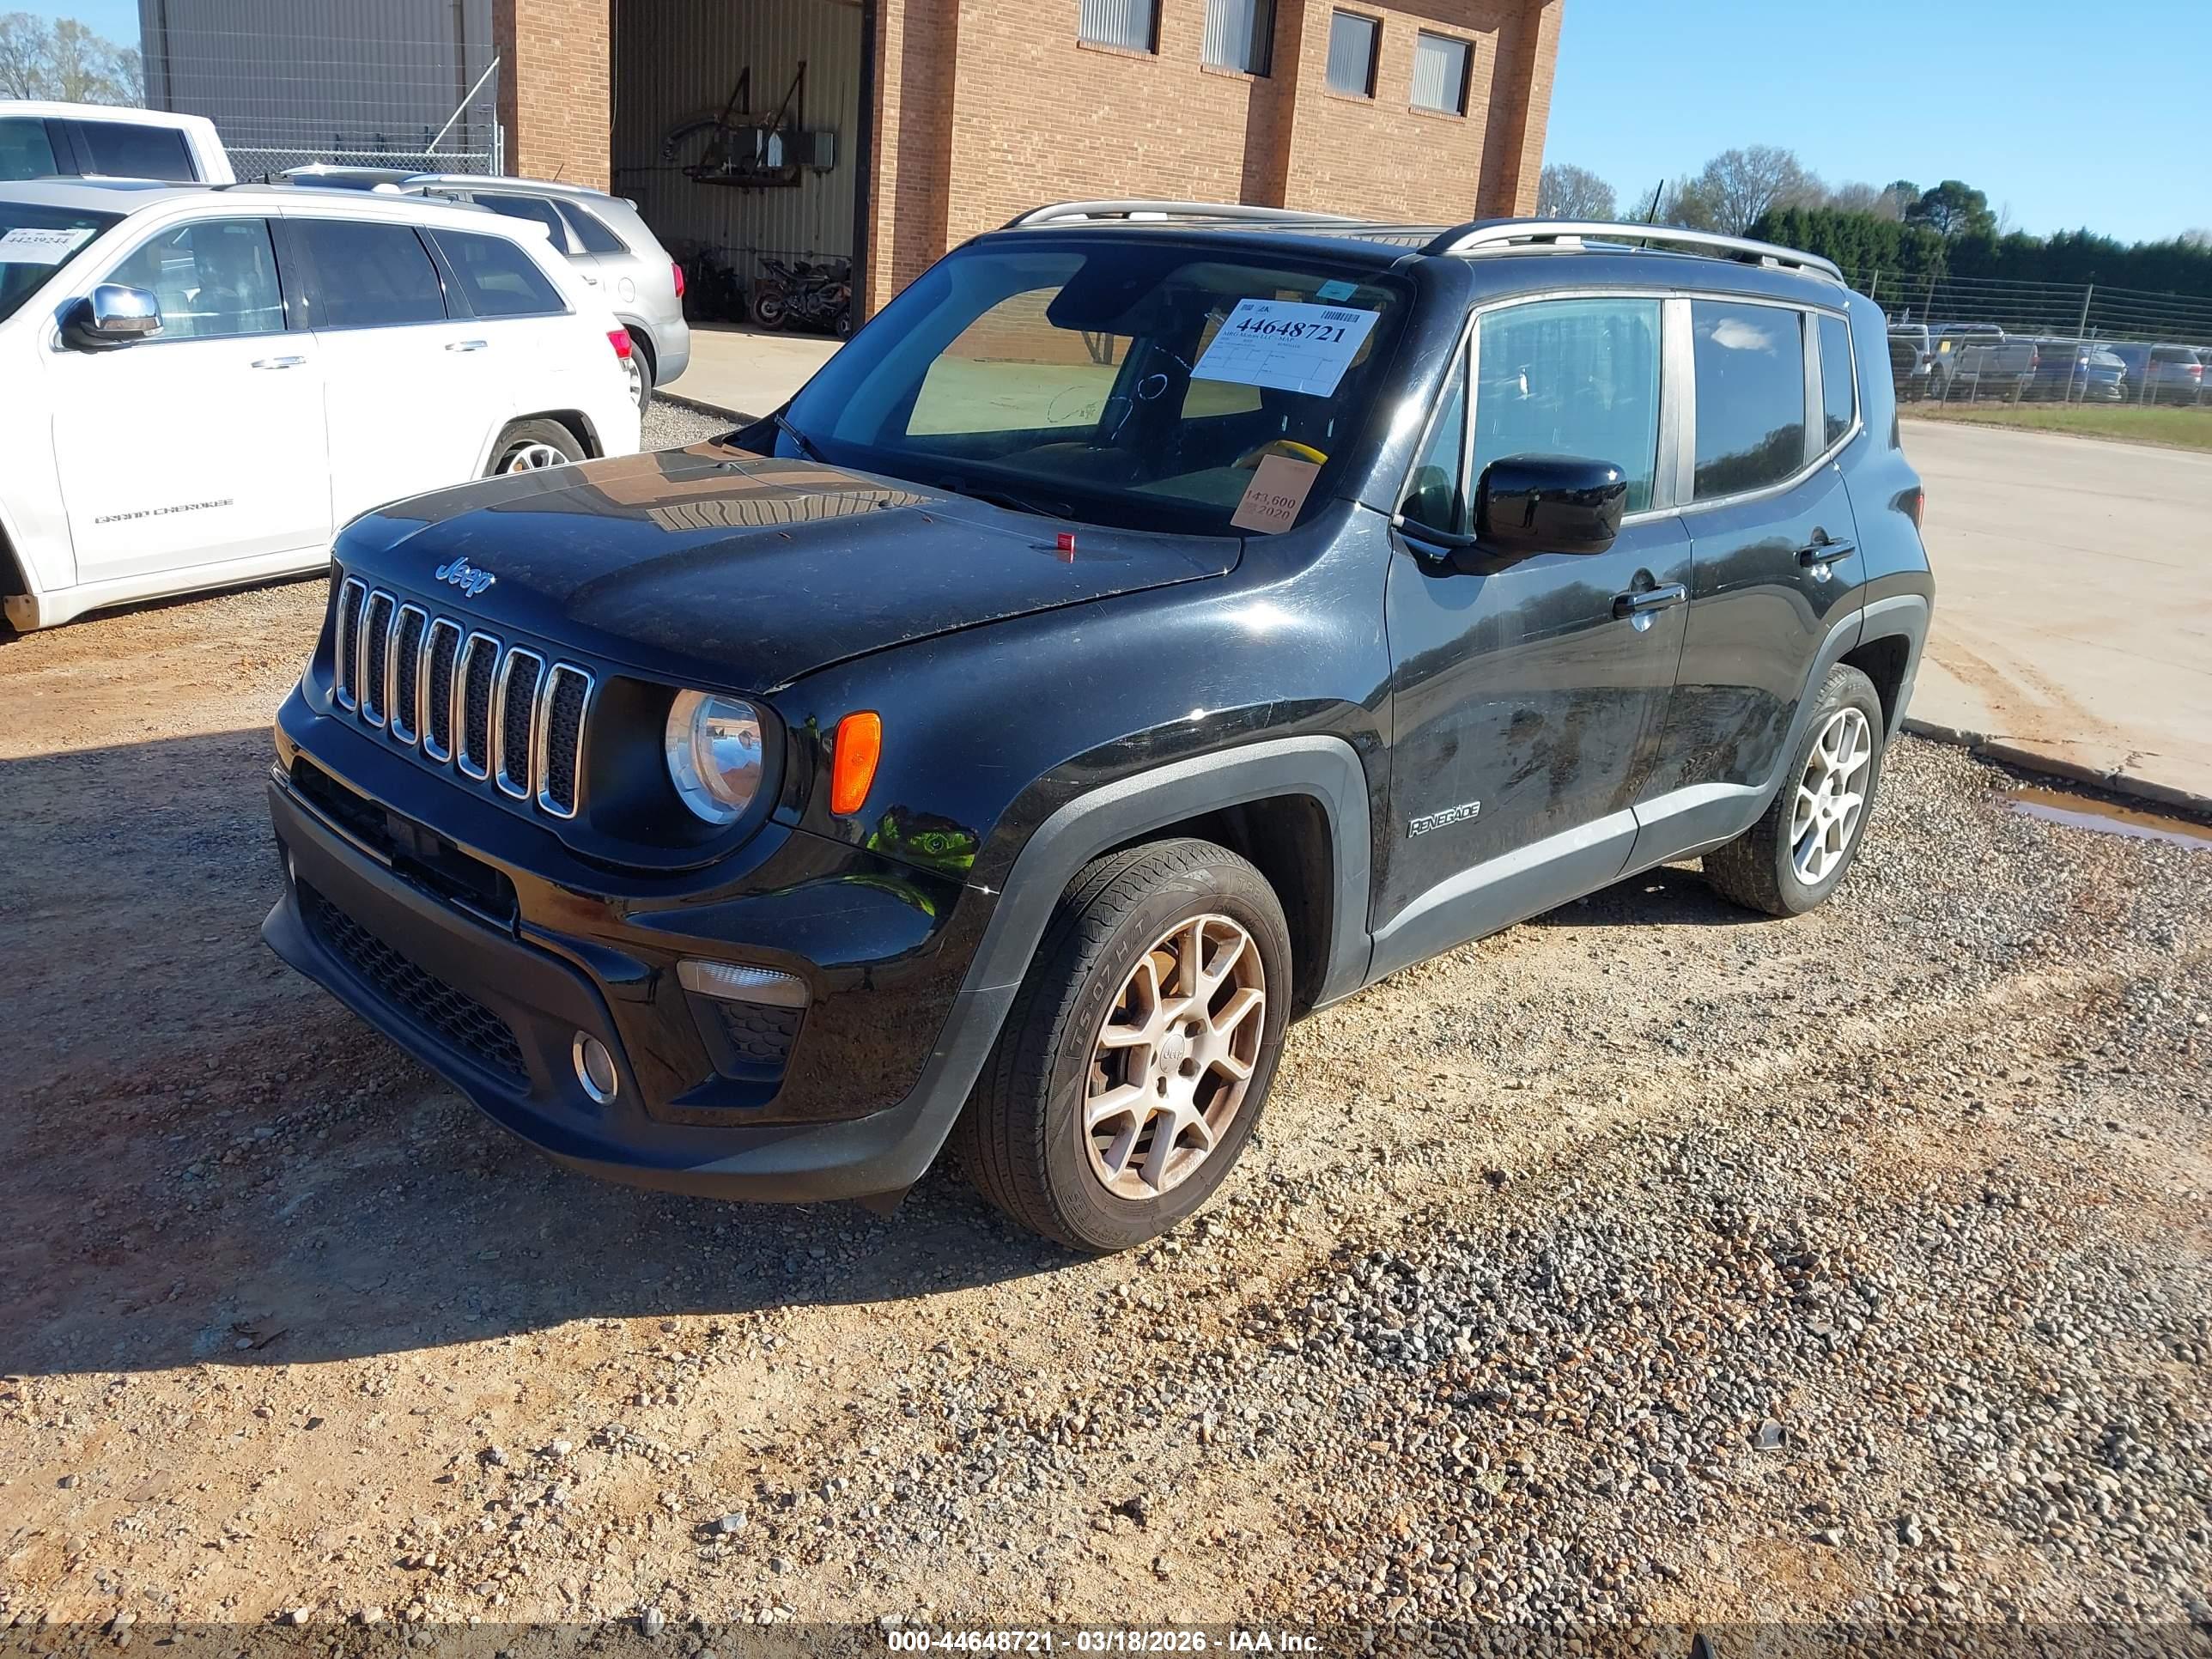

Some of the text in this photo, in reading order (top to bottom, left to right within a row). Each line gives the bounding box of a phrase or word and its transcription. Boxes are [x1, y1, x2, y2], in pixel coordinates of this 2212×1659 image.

[1236, 317, 1346, 343] 44648721
[94, 499, 234, 524] GRAND CHEROKEE
[1247, 489, 1296, 509] 143,600
[1257, 505, 1291, 520] 2020
[435, 556, 495, 598] Jeep
[1407, 799, 1481, 838] RENEGADE
[1070, 918, 1145, 1051] TS-07 H/T
[1164, 1048, 1183, 1060] Jeep
